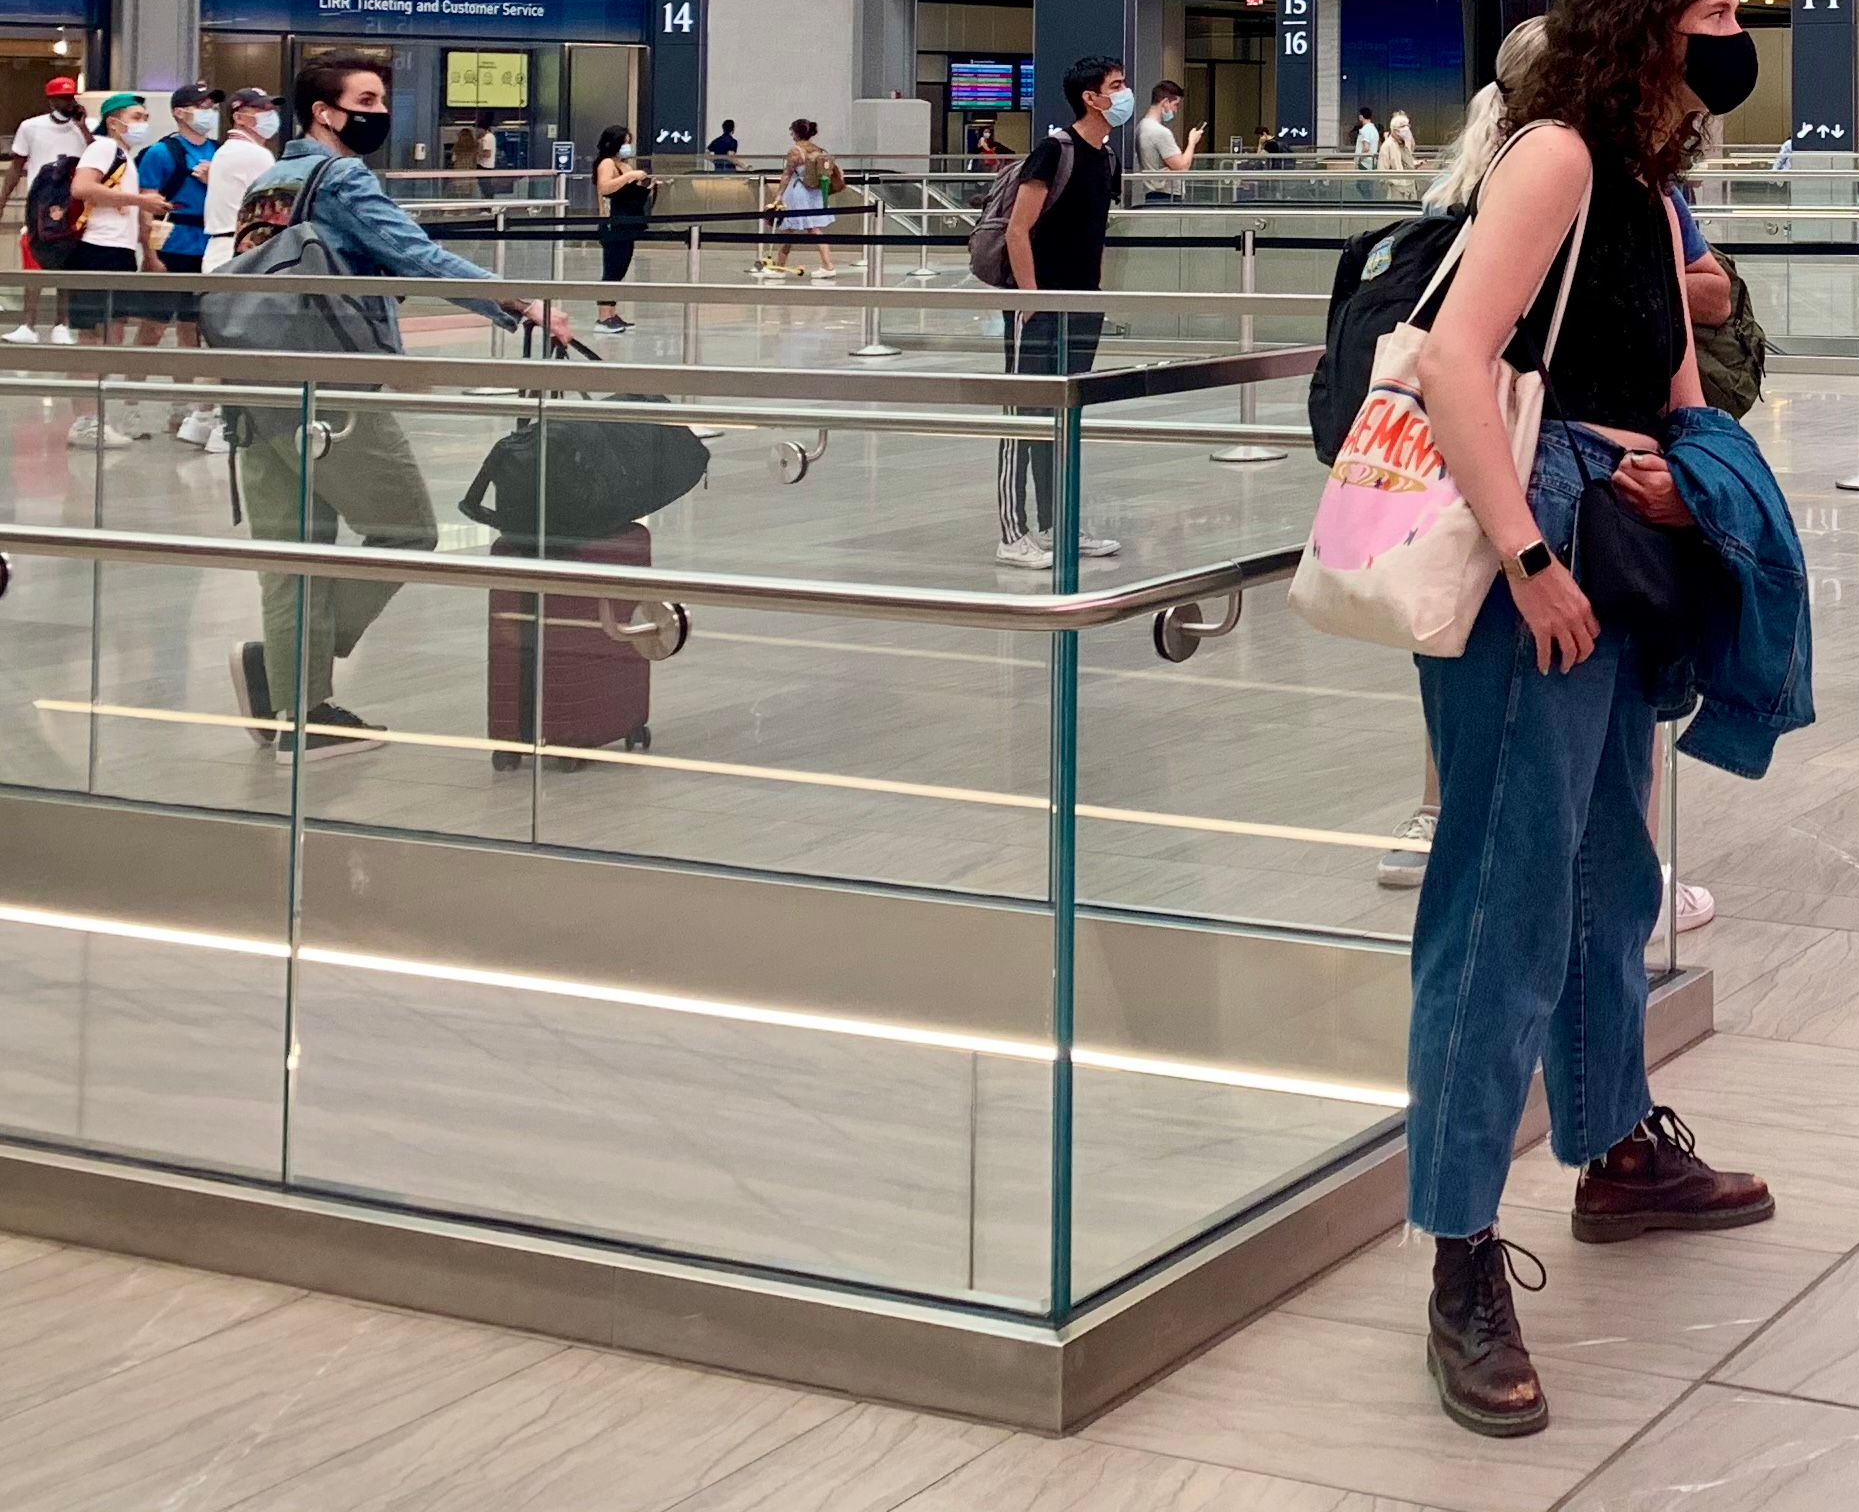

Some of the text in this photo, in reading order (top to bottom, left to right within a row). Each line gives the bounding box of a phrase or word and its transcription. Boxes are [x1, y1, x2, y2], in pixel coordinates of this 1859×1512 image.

[416, 0, 440, 13] and
[442, 0, 500, 15] Customer
[502, 2, 544, 17] Service
[663, 1, 694, 33] 14
[1284, 30, 1308, 55] 16
